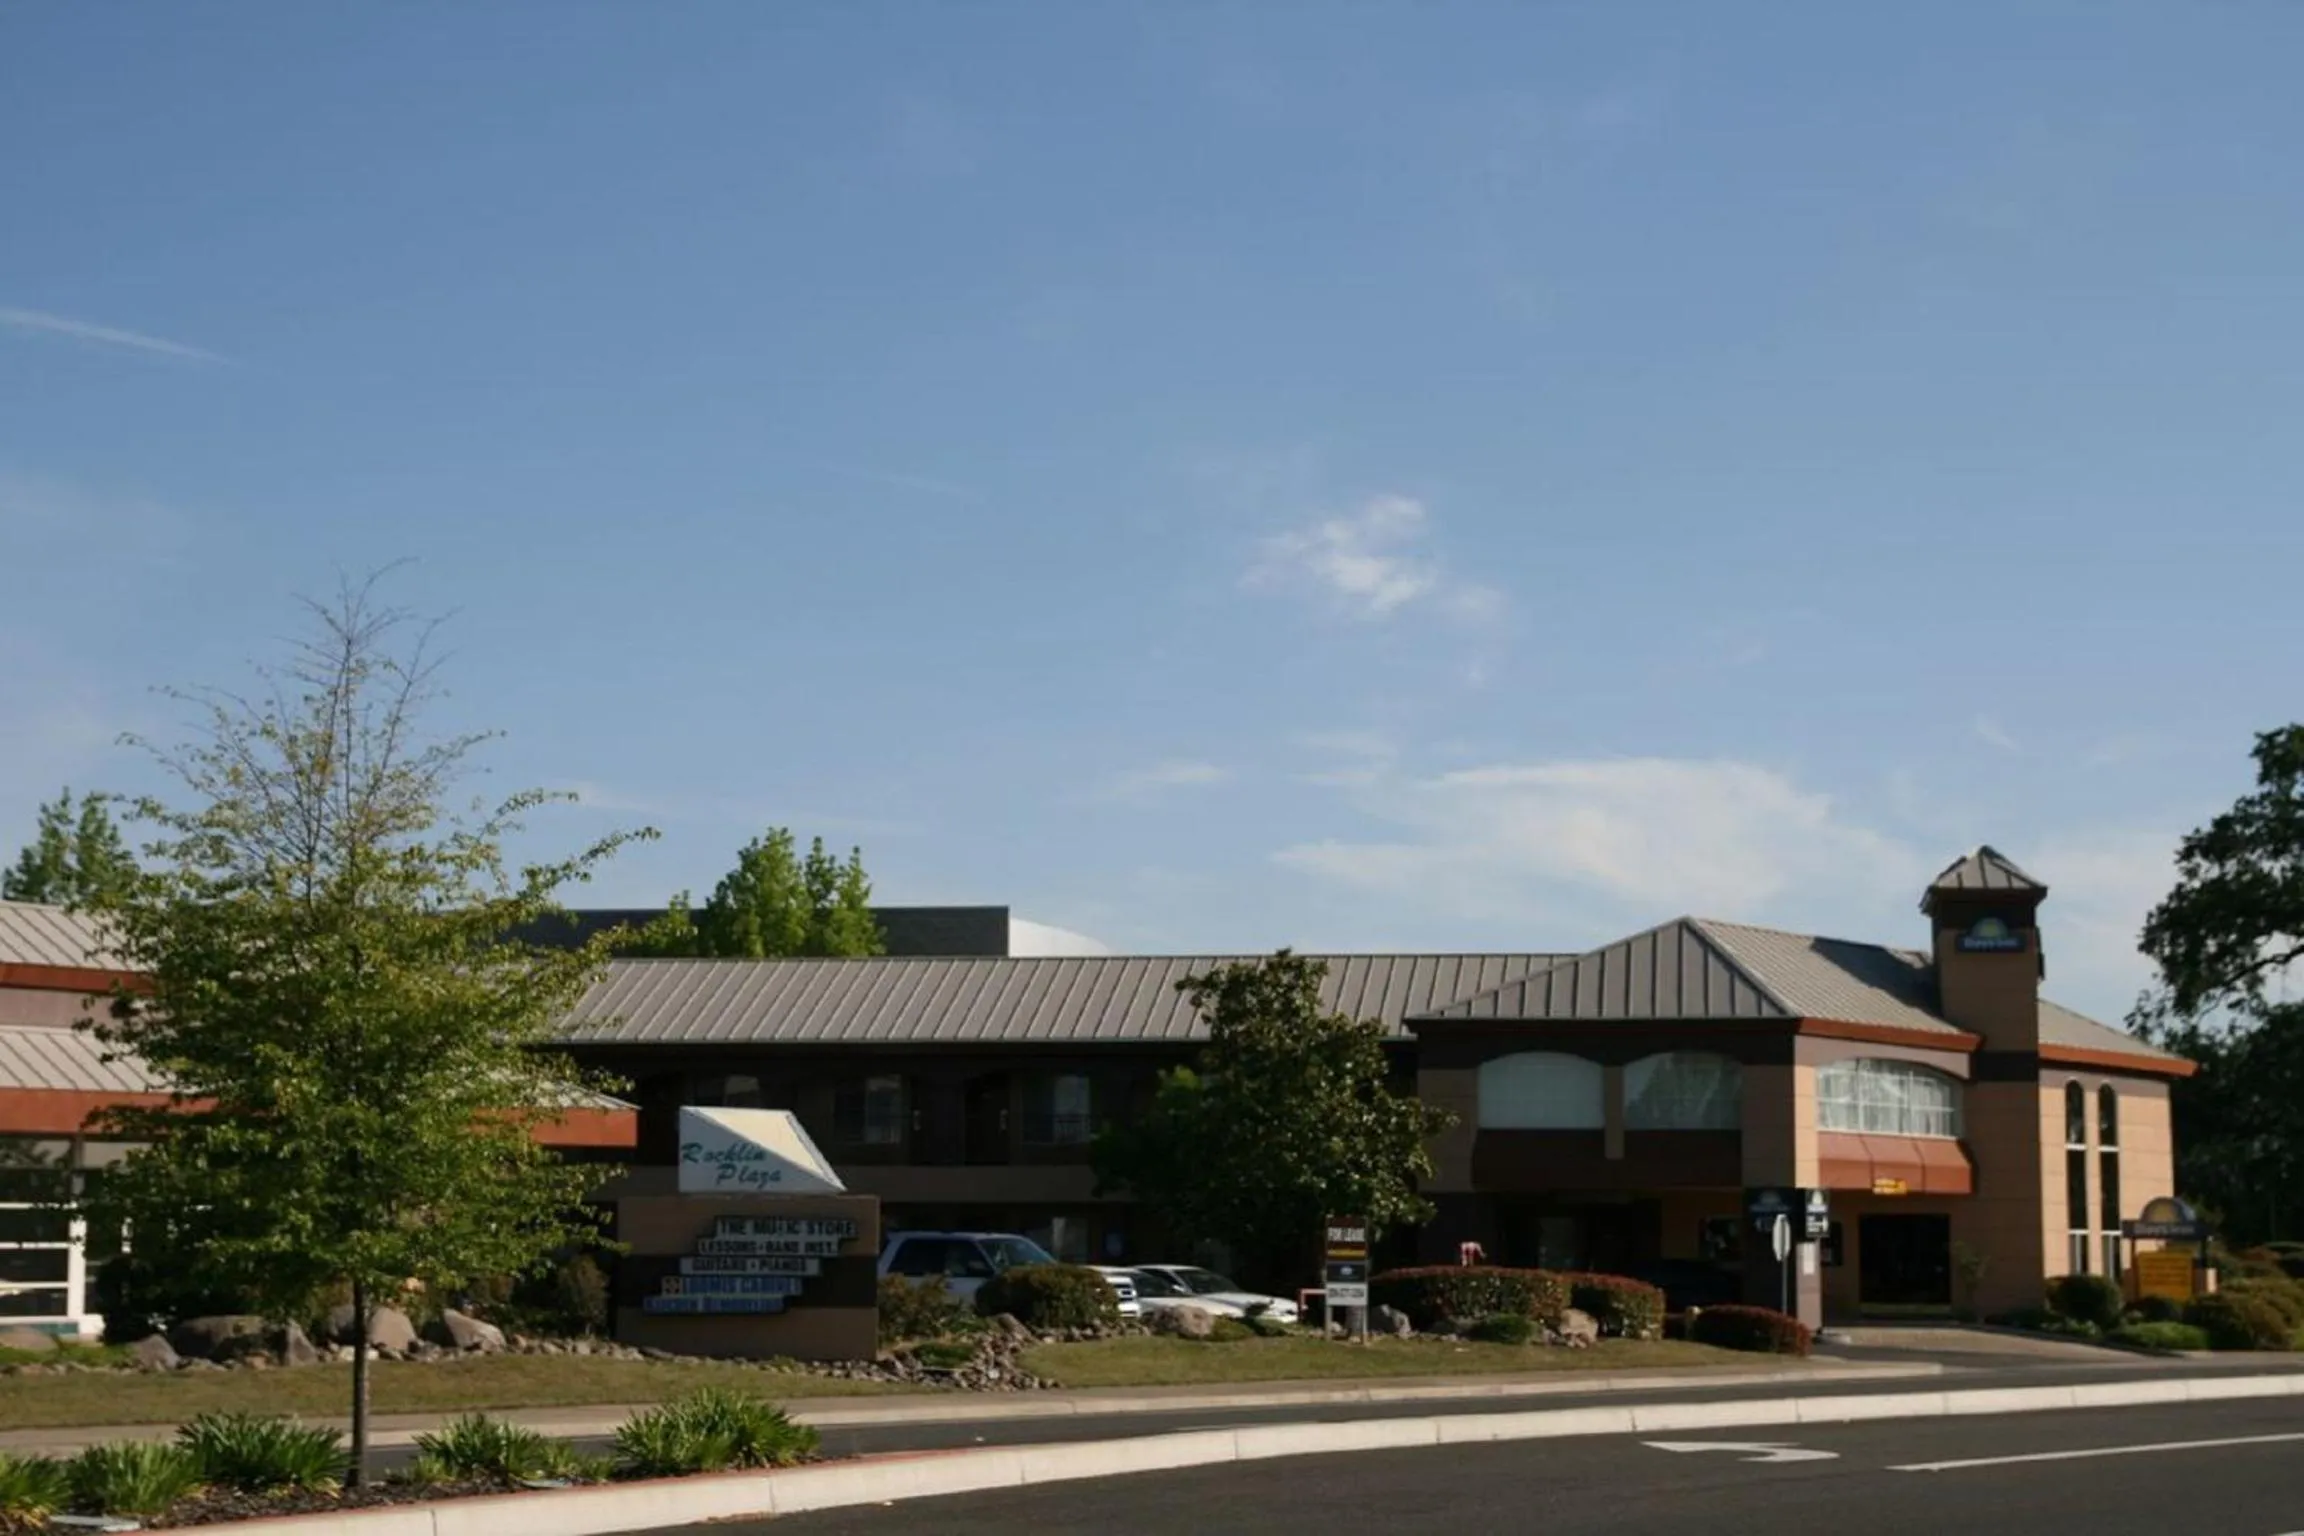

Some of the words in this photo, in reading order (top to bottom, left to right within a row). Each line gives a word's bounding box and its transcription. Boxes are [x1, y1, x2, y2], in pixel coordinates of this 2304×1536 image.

[680, 1142, 767, 1164] Rocklin
[716, 1162, 782, 1189] Plaza
[720, 1220, 748, 1236] THE
[807, 1221, 853, 1237] STORE
[700, 1240, 757, 1253] LESSONS
